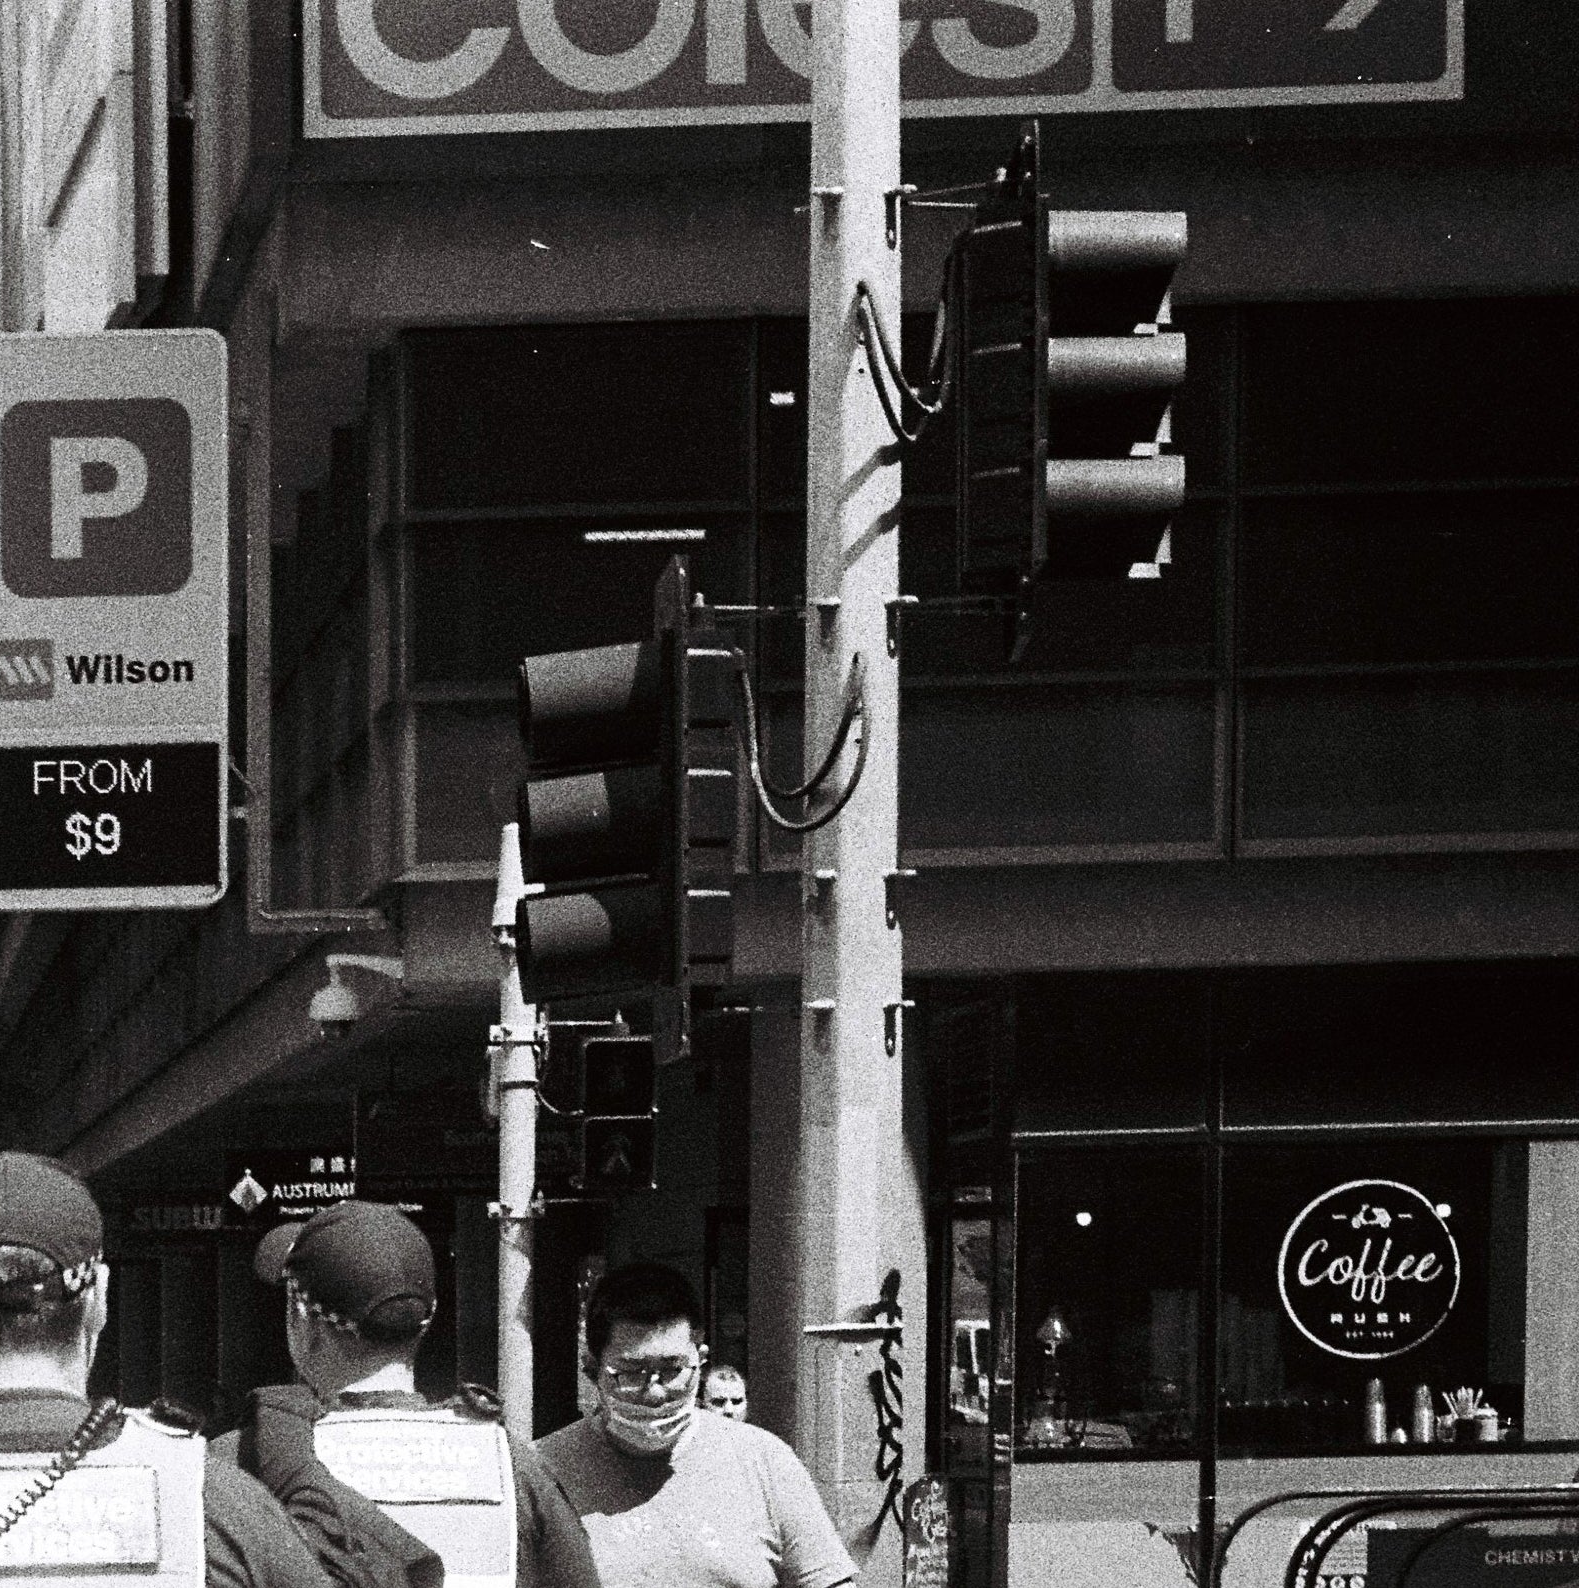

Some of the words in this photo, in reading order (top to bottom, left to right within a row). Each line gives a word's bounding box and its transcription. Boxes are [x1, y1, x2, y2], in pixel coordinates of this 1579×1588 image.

[50, 435, 149, 560] P
[66, 653, 195, 685] Wilson
[32, 759, 154, 795] FROM
[65, 811, 122, 860] $9
[1297, 1237, 1443, 1305] Coffee
[315, 1437, 480, 1467] Protective
[1484, 1550, 1566, 1566] CHEMIST
